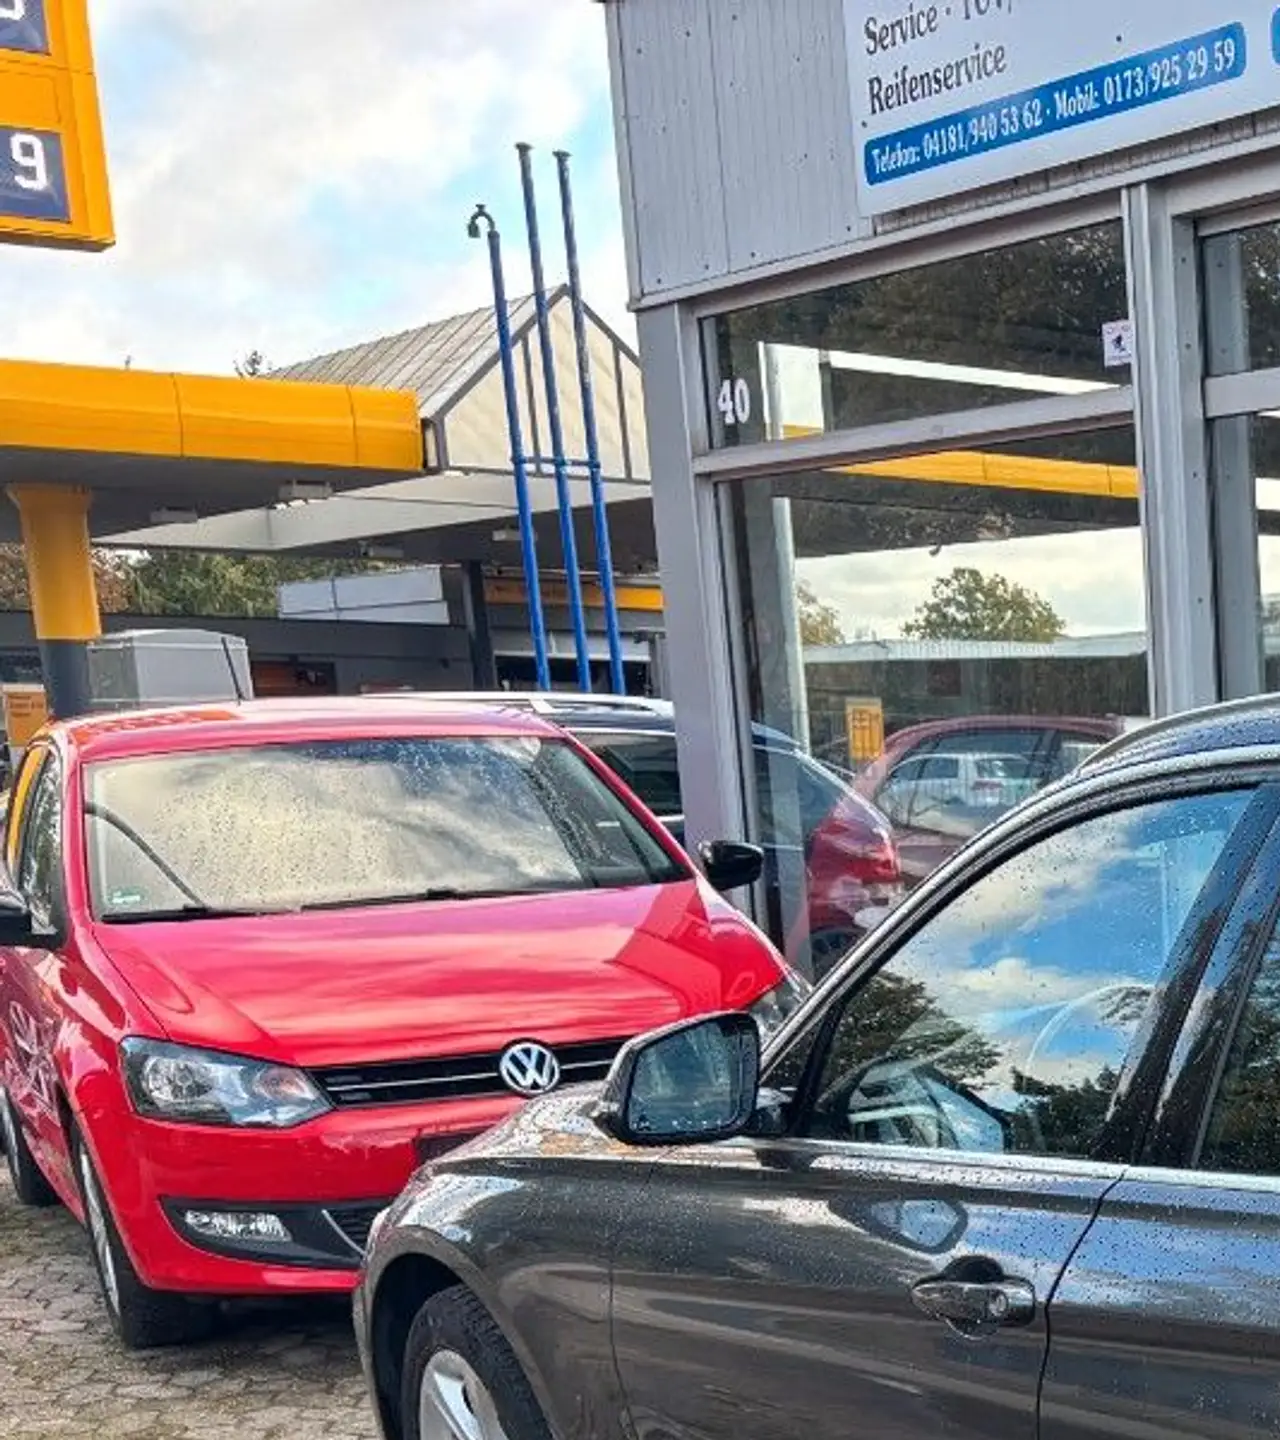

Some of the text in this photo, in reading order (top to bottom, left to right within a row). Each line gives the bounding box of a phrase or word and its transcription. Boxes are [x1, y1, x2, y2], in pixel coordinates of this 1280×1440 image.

[864, 2, 938, 56] Service
[867, 42, 1007, 116] Reifenservice
[922, 112, 998, 162] 04181/940
[1000, 105, 1019, 136] 53
[1022, 98, 1043, 128] 62
[1103, 55, 1182, 105] 0173/925
[1187, 47, 1208, 81] 29
[1214, 38, 1235, 72] 59
[10, 132, 47, 191] 9
[717, 378, 751, 424] 40
